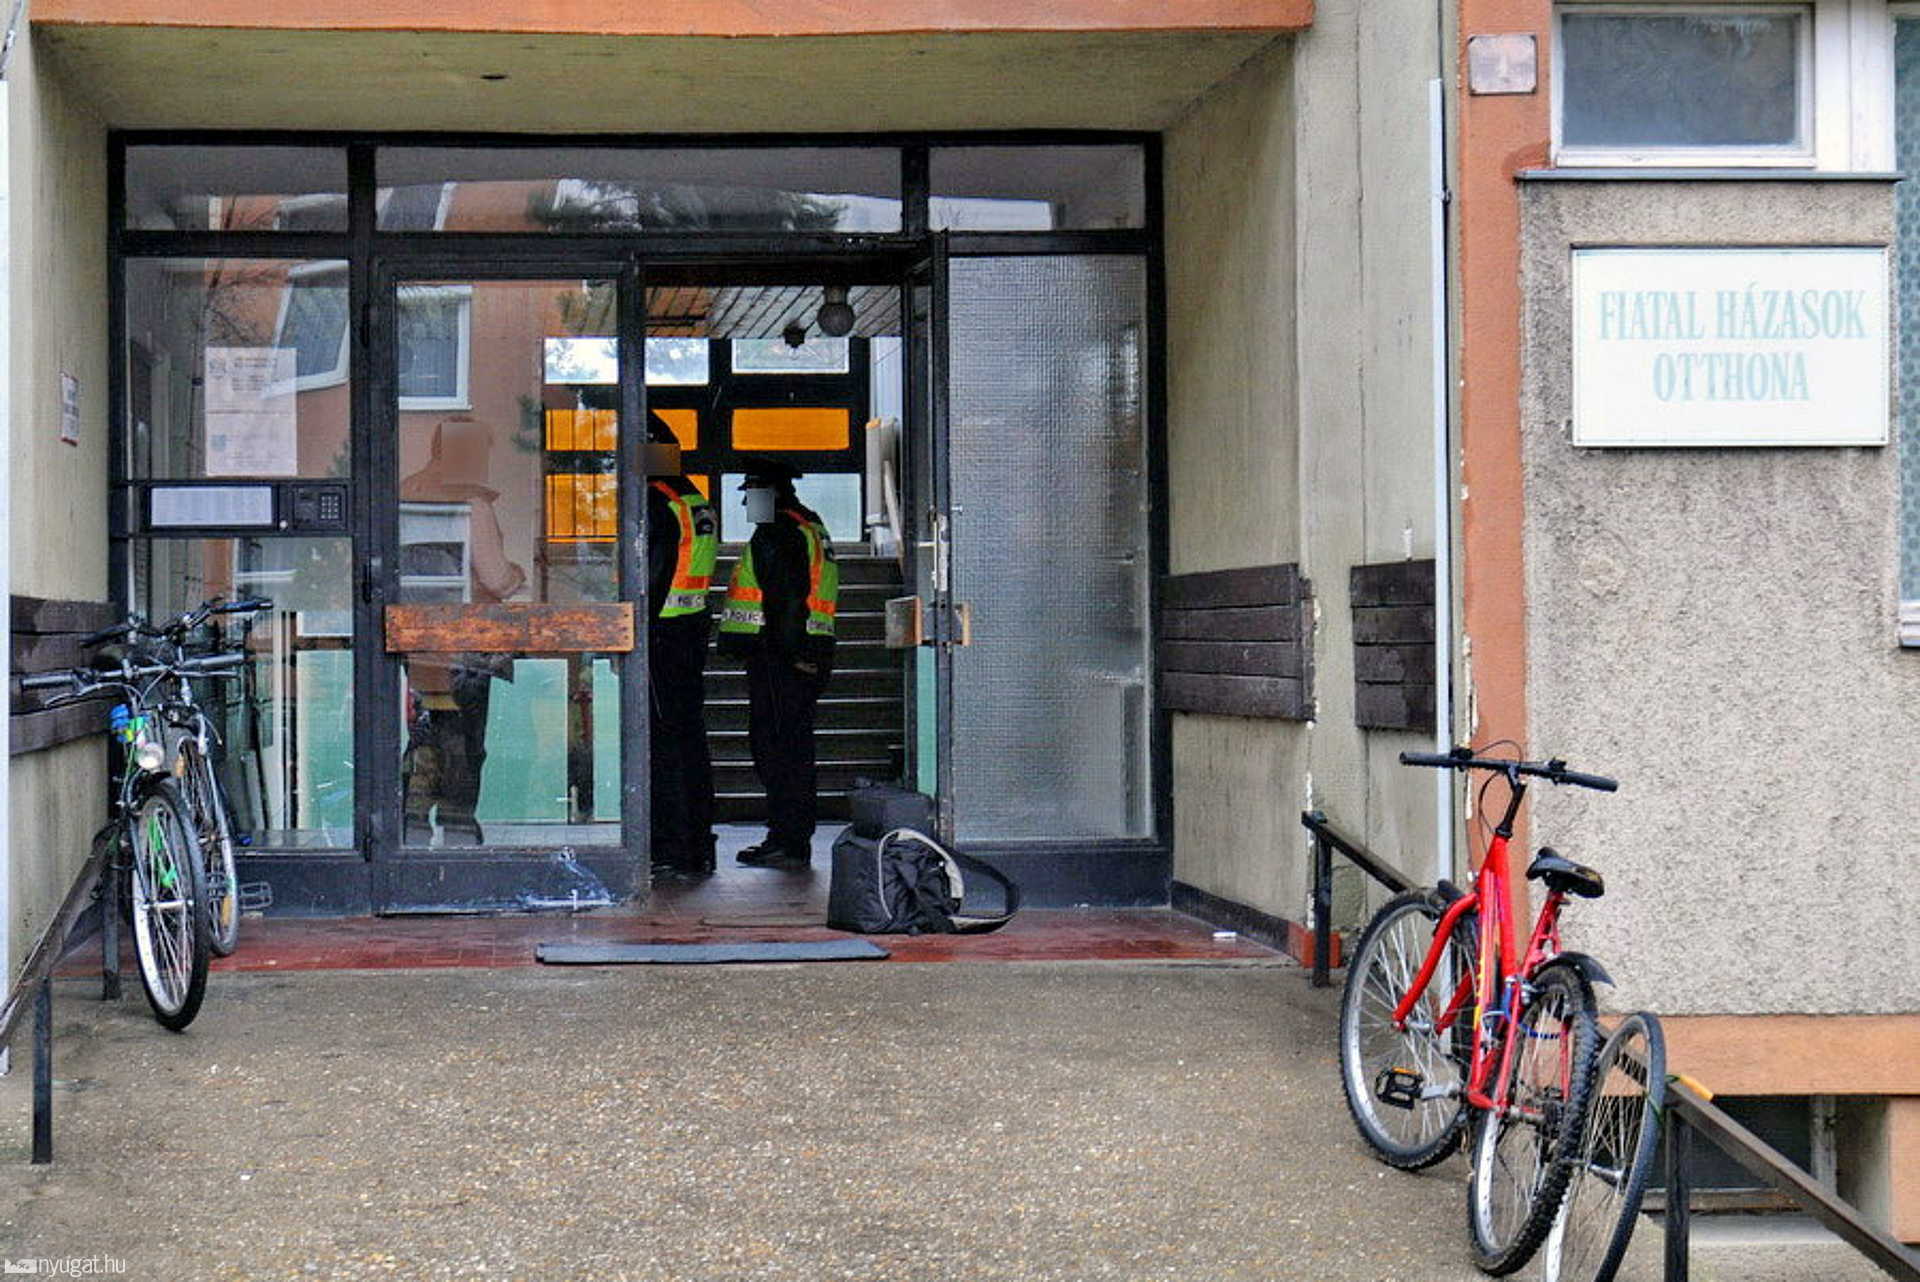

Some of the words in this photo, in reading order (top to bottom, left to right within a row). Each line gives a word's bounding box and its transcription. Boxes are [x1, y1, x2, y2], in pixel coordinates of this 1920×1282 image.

[1599, 290, 1704, 340] FIATAL
[1715, 281, 1868, 341] HÁZASOK
[1652, 352, 1810, 401] OTTHONA
